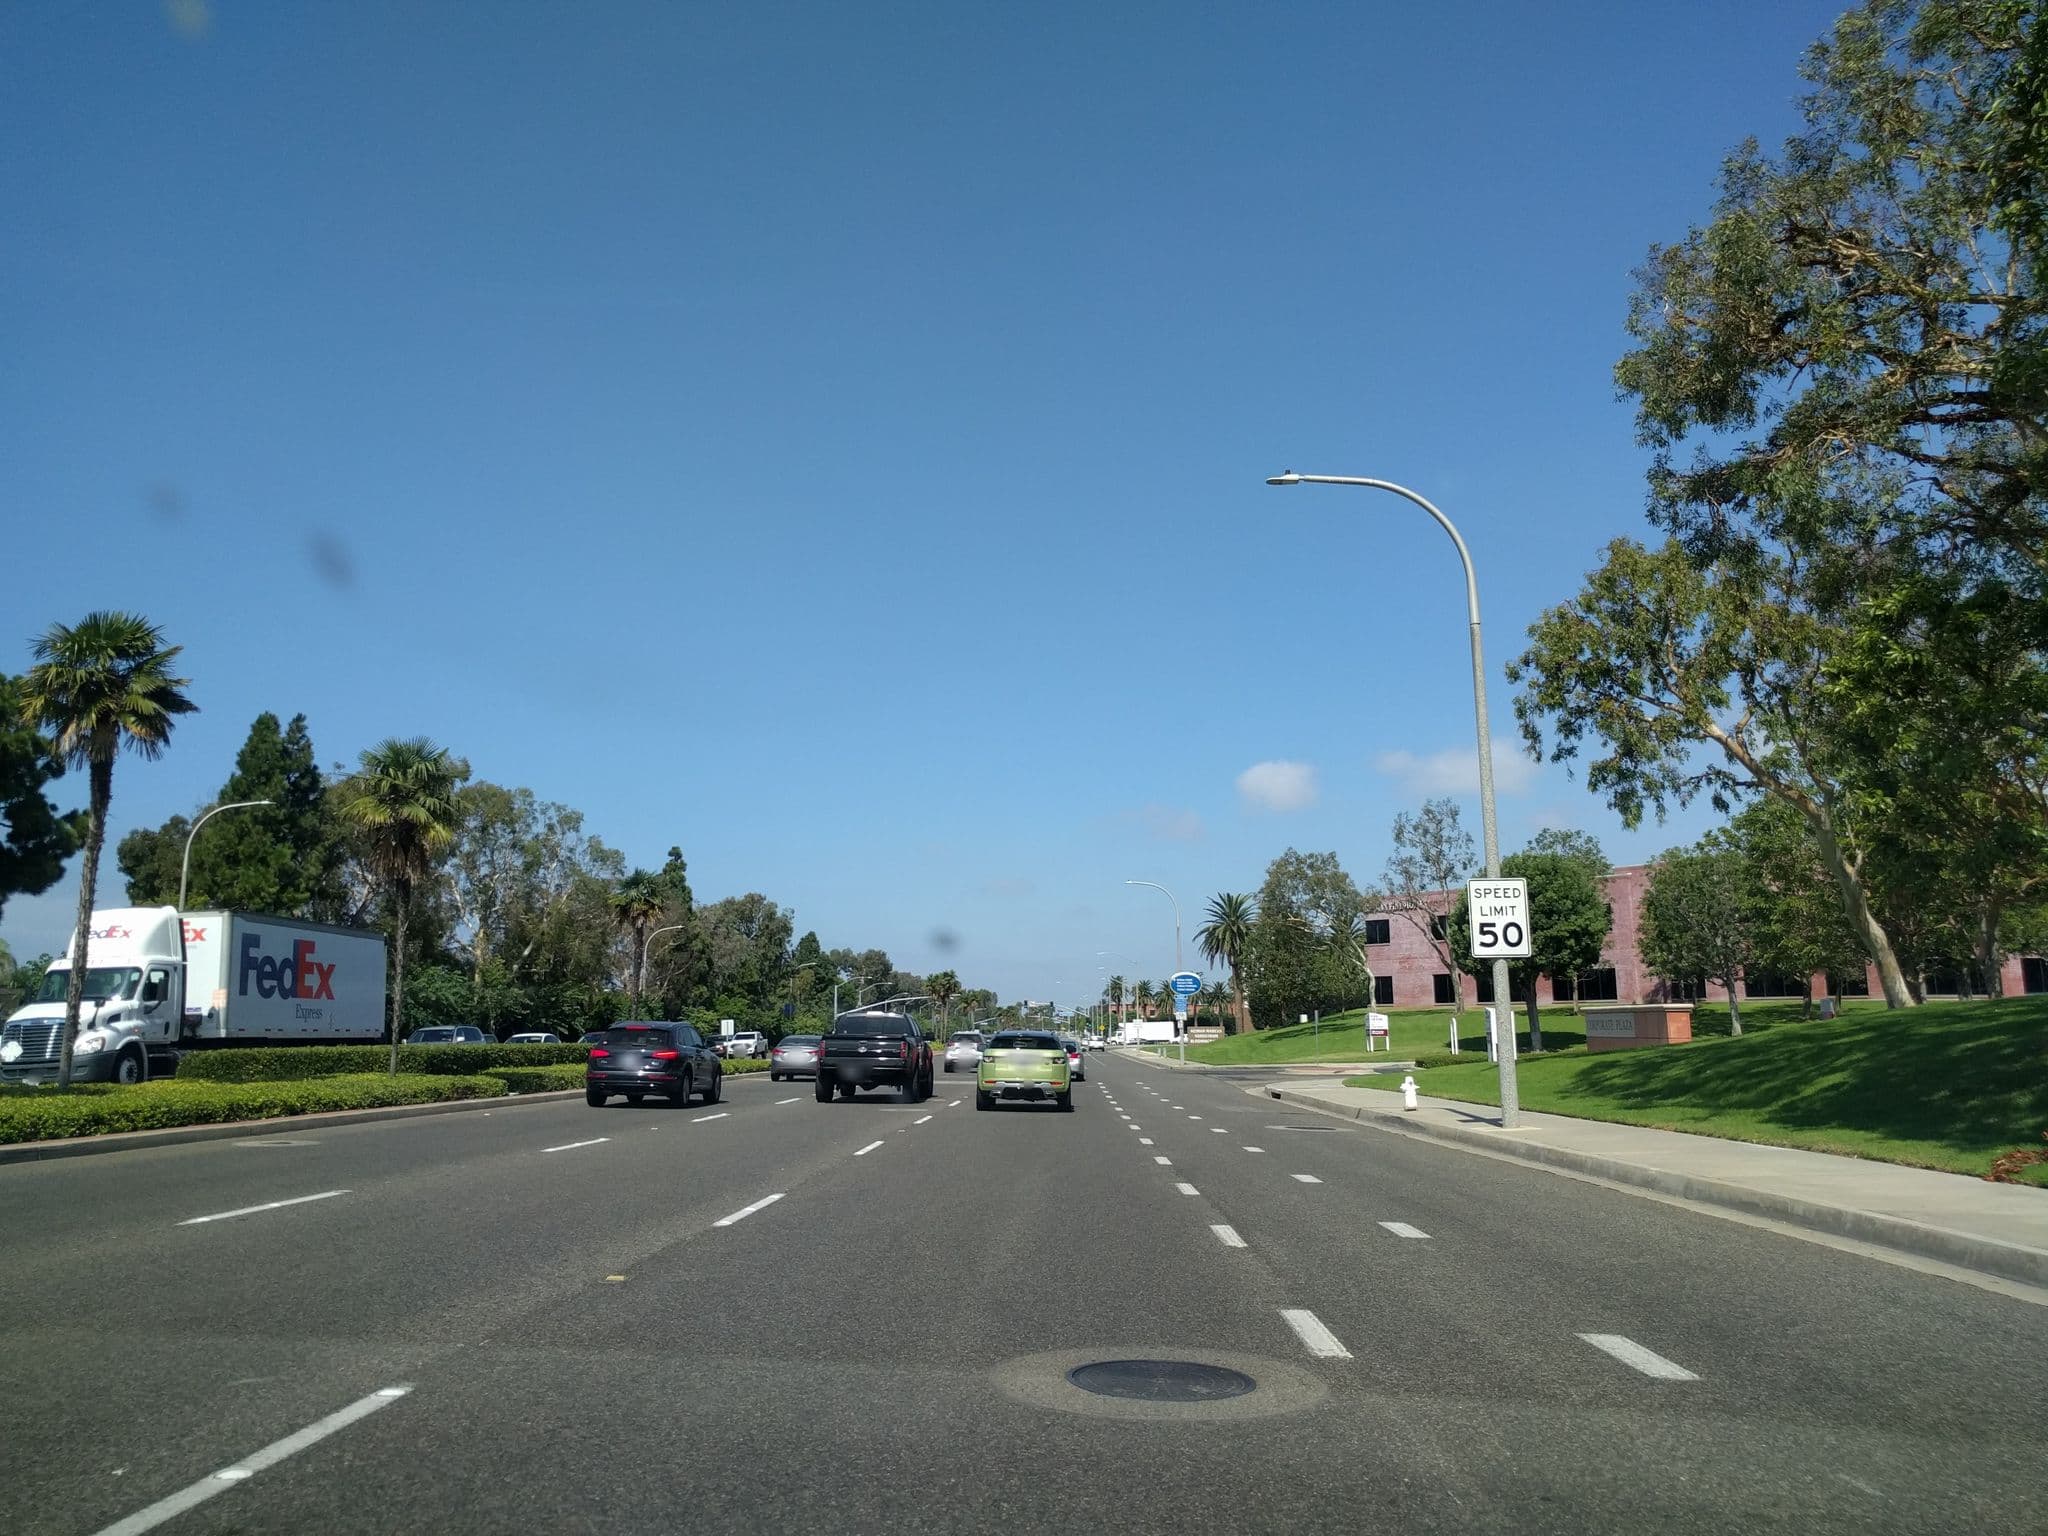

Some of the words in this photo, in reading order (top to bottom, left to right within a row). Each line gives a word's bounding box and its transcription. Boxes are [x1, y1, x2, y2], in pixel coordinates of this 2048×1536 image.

[1474, 888, 1521, 899] SPEED
[1480, 906, 1516, 917] LIMIT
[87, 925, 133, 940] edEx
[1479, 921, 1523, 948] 50
[239, 932, 336, 1000] FedEx
[296, 1003, 324, 1023] Express
